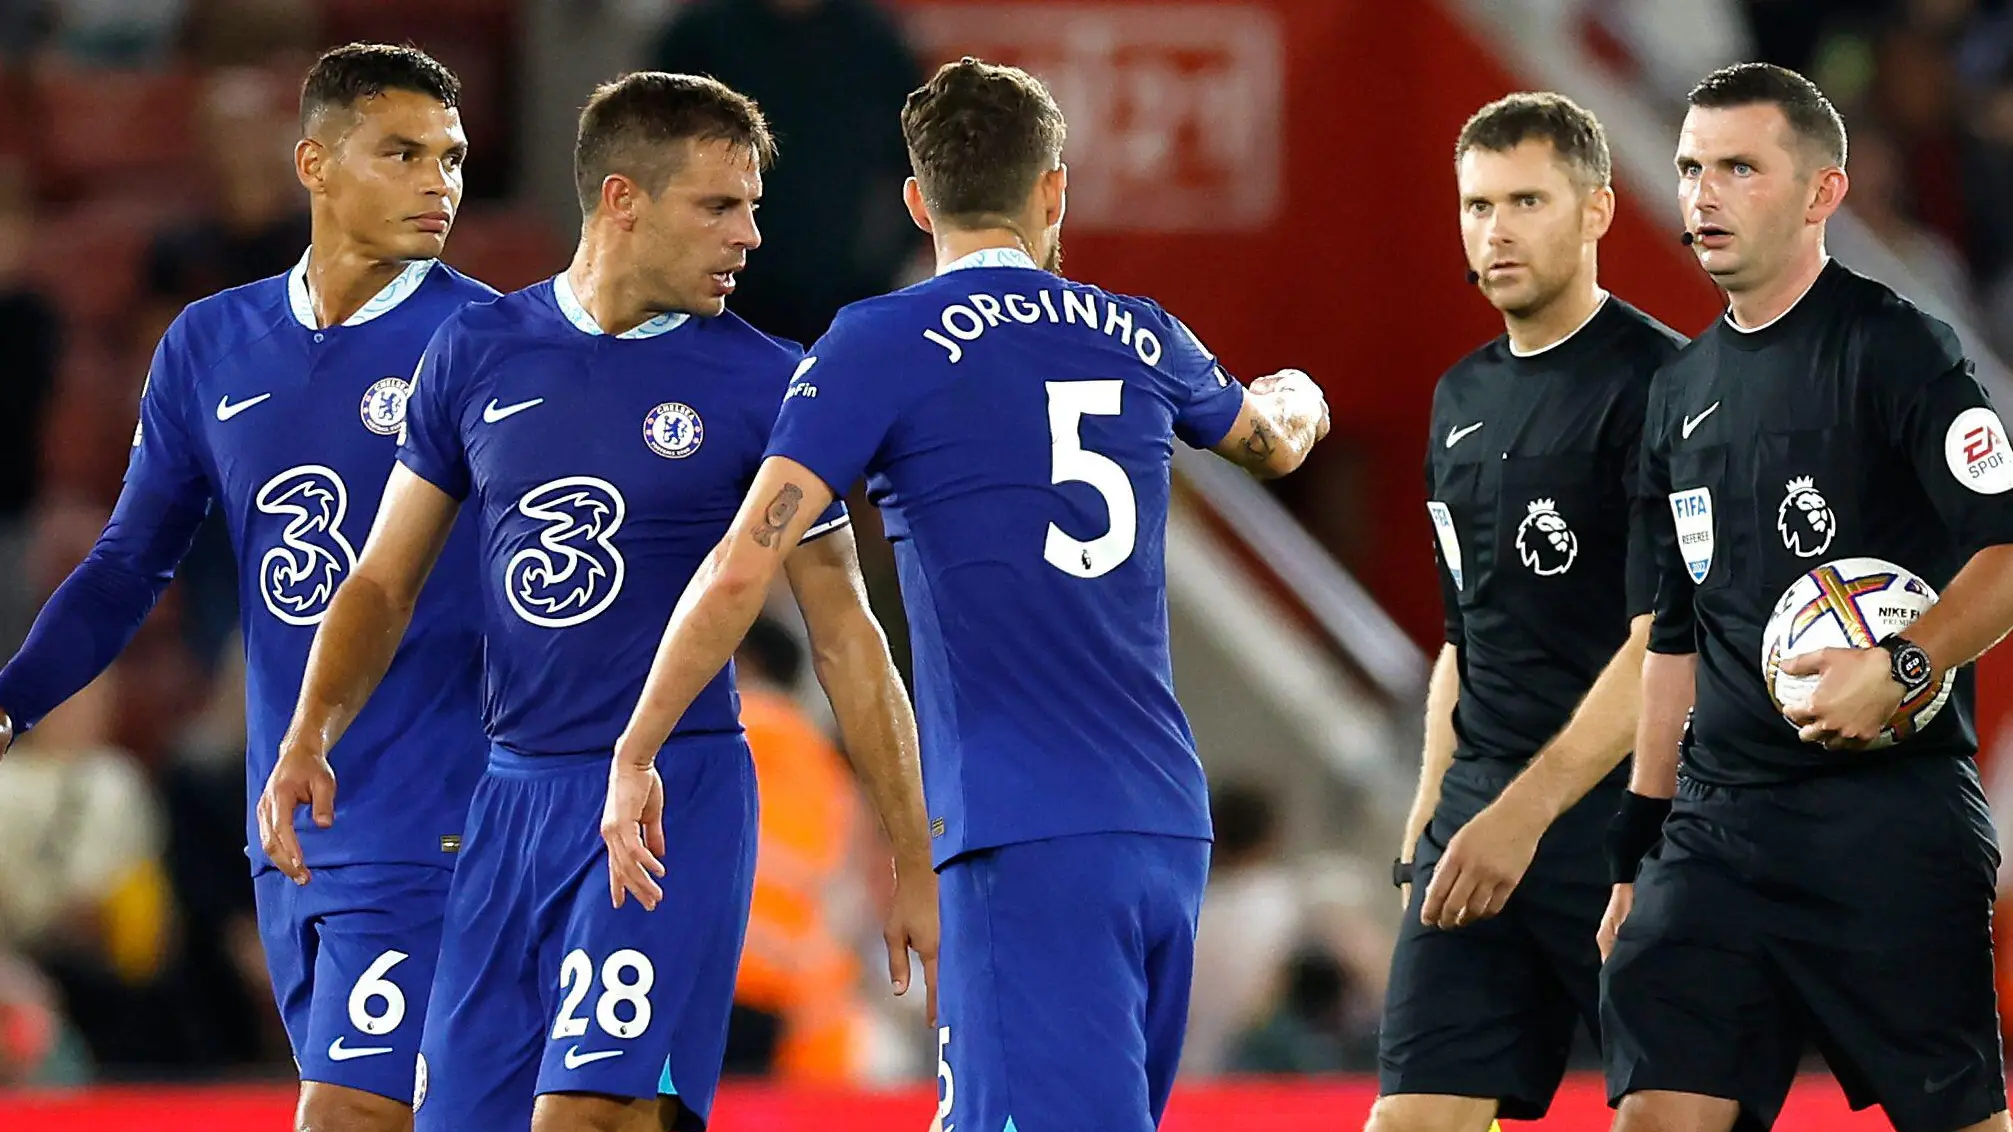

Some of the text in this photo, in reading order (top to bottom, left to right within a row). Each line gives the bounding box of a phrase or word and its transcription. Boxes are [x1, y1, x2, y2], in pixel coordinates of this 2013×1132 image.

[922, 289, 1162, 365] JORGINHO
[656, 404, 695, 420] CHELSEA
[1044, 379, 1137, 578] 5
[1674, 495, 1707, 519] FIFA
[1681, 531, 1710, 545] REFEREE
[1878, 607, 1908, 618] NIKE
[348, 949, 410, 1036] 6
[551, 948, 655, 1039] 28
